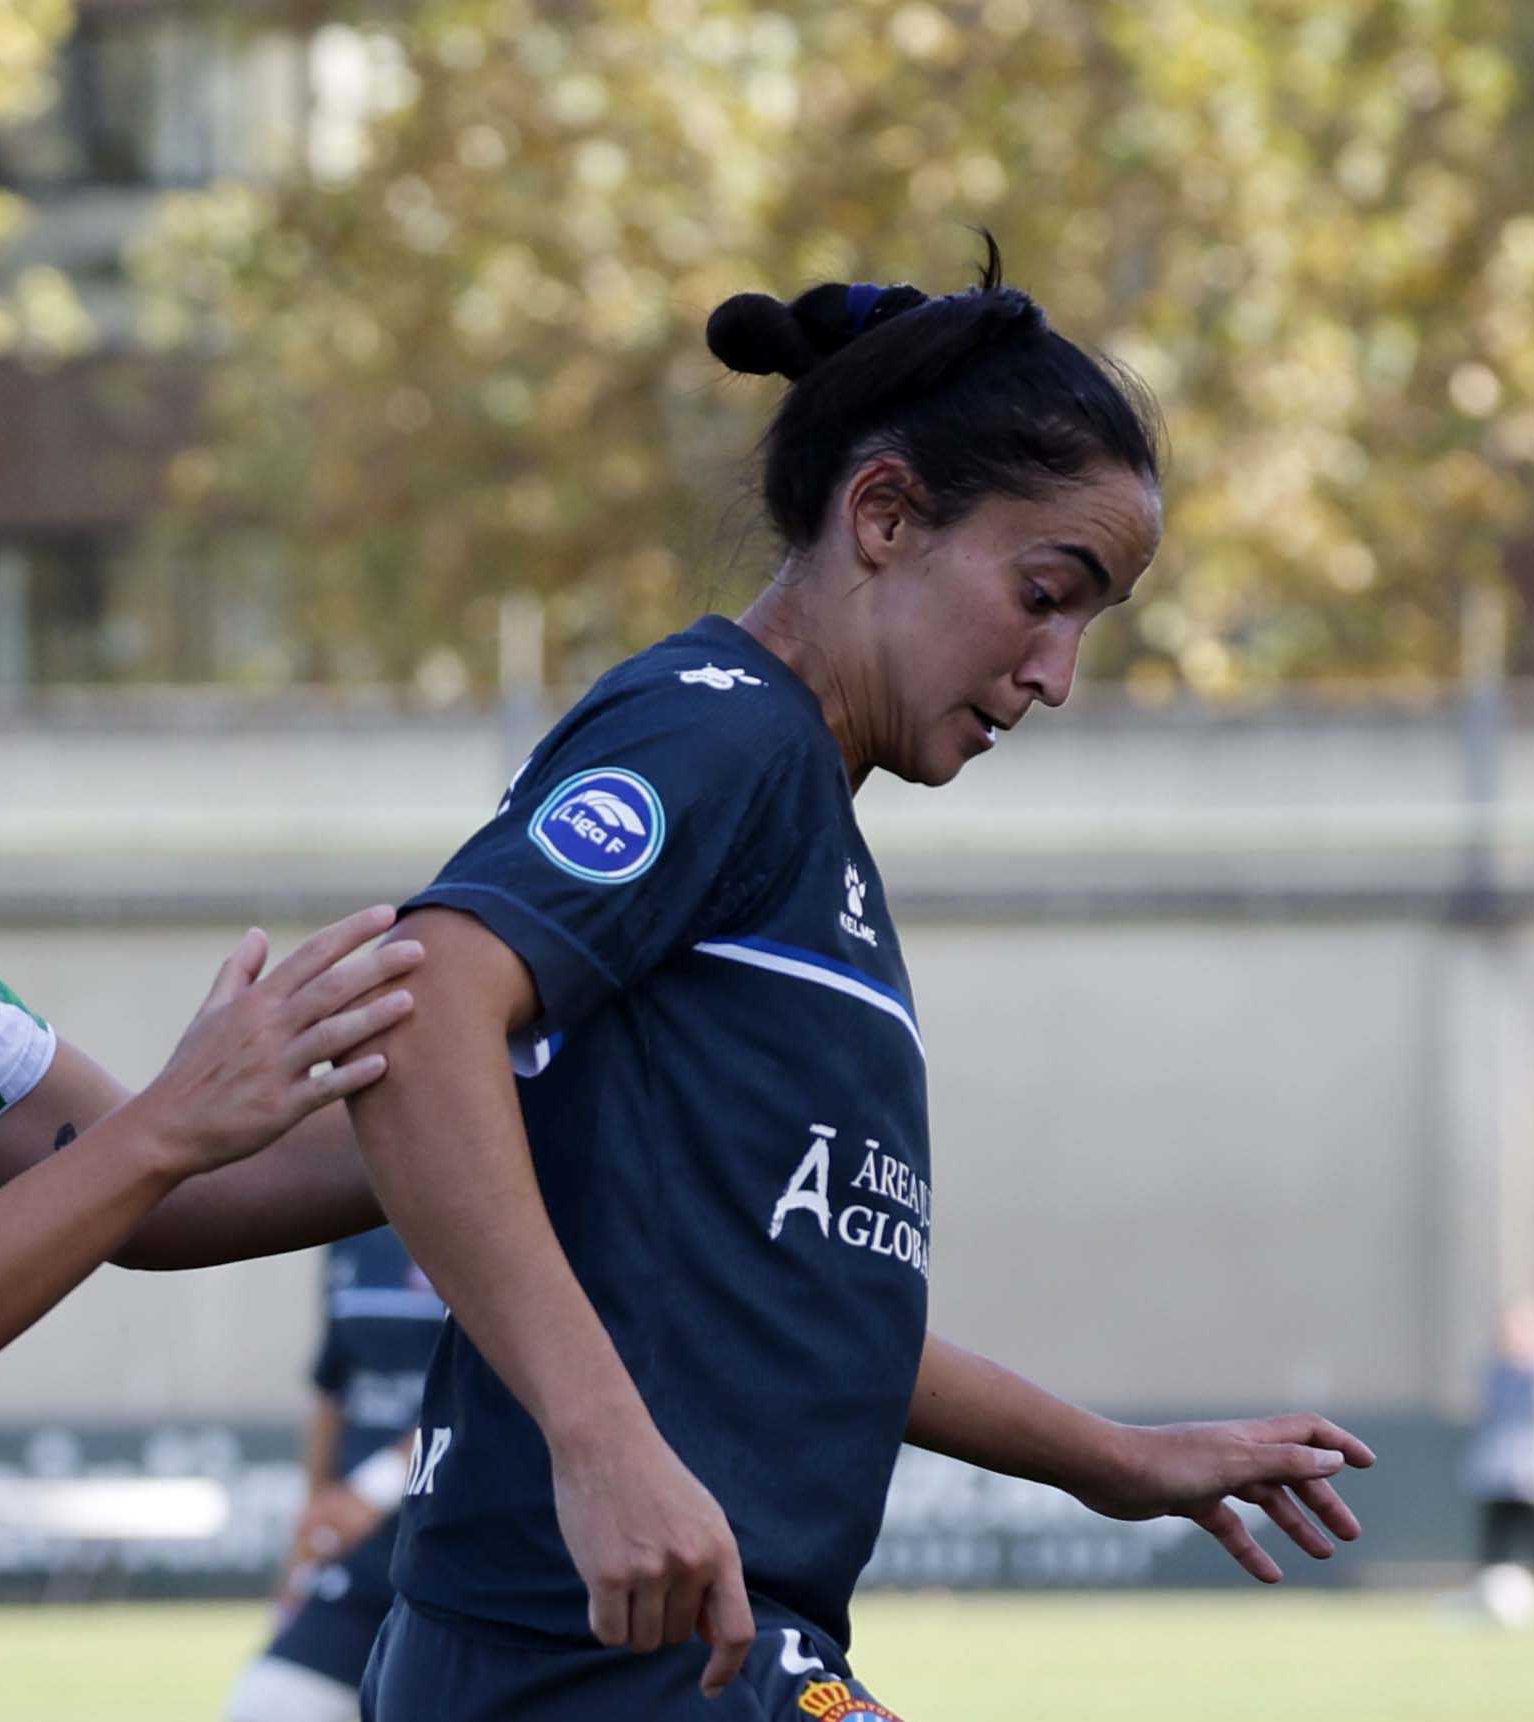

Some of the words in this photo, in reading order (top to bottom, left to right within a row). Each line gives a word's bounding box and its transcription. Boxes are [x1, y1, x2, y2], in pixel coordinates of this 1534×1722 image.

[559, 805, 608, 846] Liga
[605, 836, 627, 854] F
[839, 911, 878, 948] KELME
